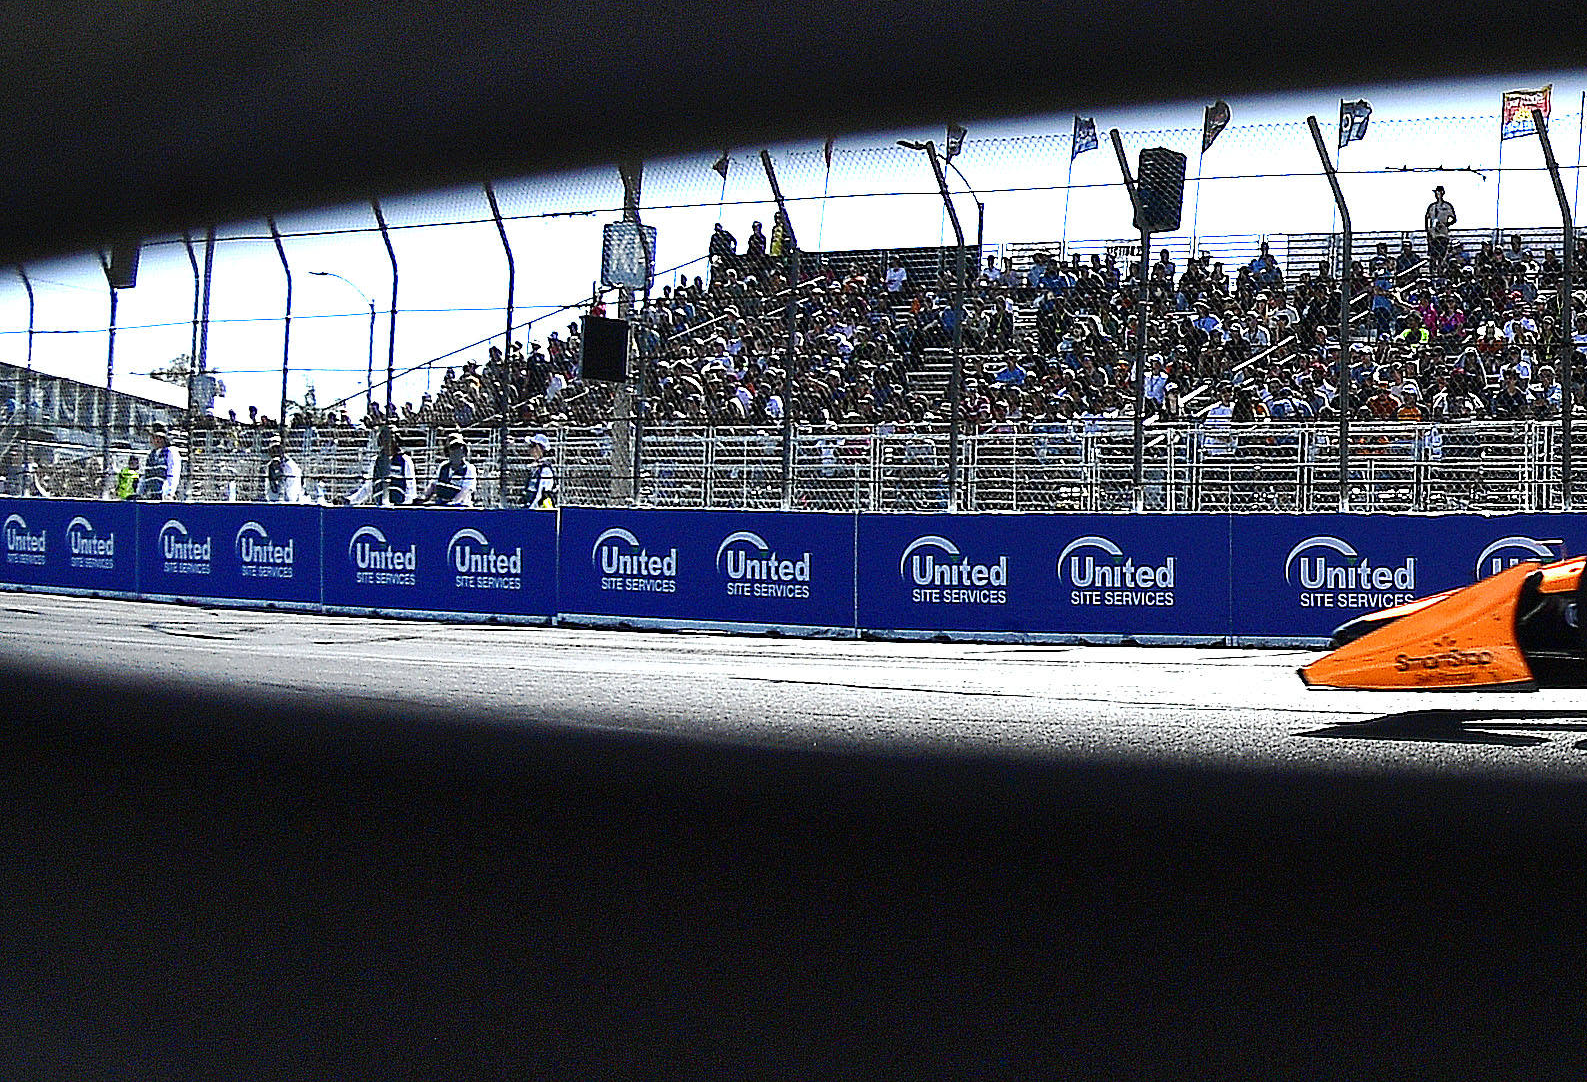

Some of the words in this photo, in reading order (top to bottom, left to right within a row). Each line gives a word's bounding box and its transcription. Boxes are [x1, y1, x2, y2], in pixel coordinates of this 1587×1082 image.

[7, 529, 46, 551] United
[71, 531, 114, 556] United
[164, 535, 211, 560] United
[242, 538, 294, 564] United
[356, 543, 416, 570] United
[455, 546, 521, 574] United
[601, 546, 677, 576] United
[727, 550, 810, 581] United
[456, 575, 474, 588] SITE
[477, 576, 520, 590] SERVICES
[912, 555, 1007, 586] United
[1070, 556, 1174, 588] United
[1300, 557, 1415, 590] United
[601, 577, 623, 590] SITE
[625, 579, 676, 593] SERVICES
[727, 583, 751, 596] SITE
[753, 583, 809, 598] SERVICES
[912, 589, 940, 603] SITE
[943, 590, 1007, 604] SERVICES
[1070, 591, 1101, 605] SITE
[1105, 592, 1174, 606] SERVICES
[1300, 593, 1334, 607] SITE
